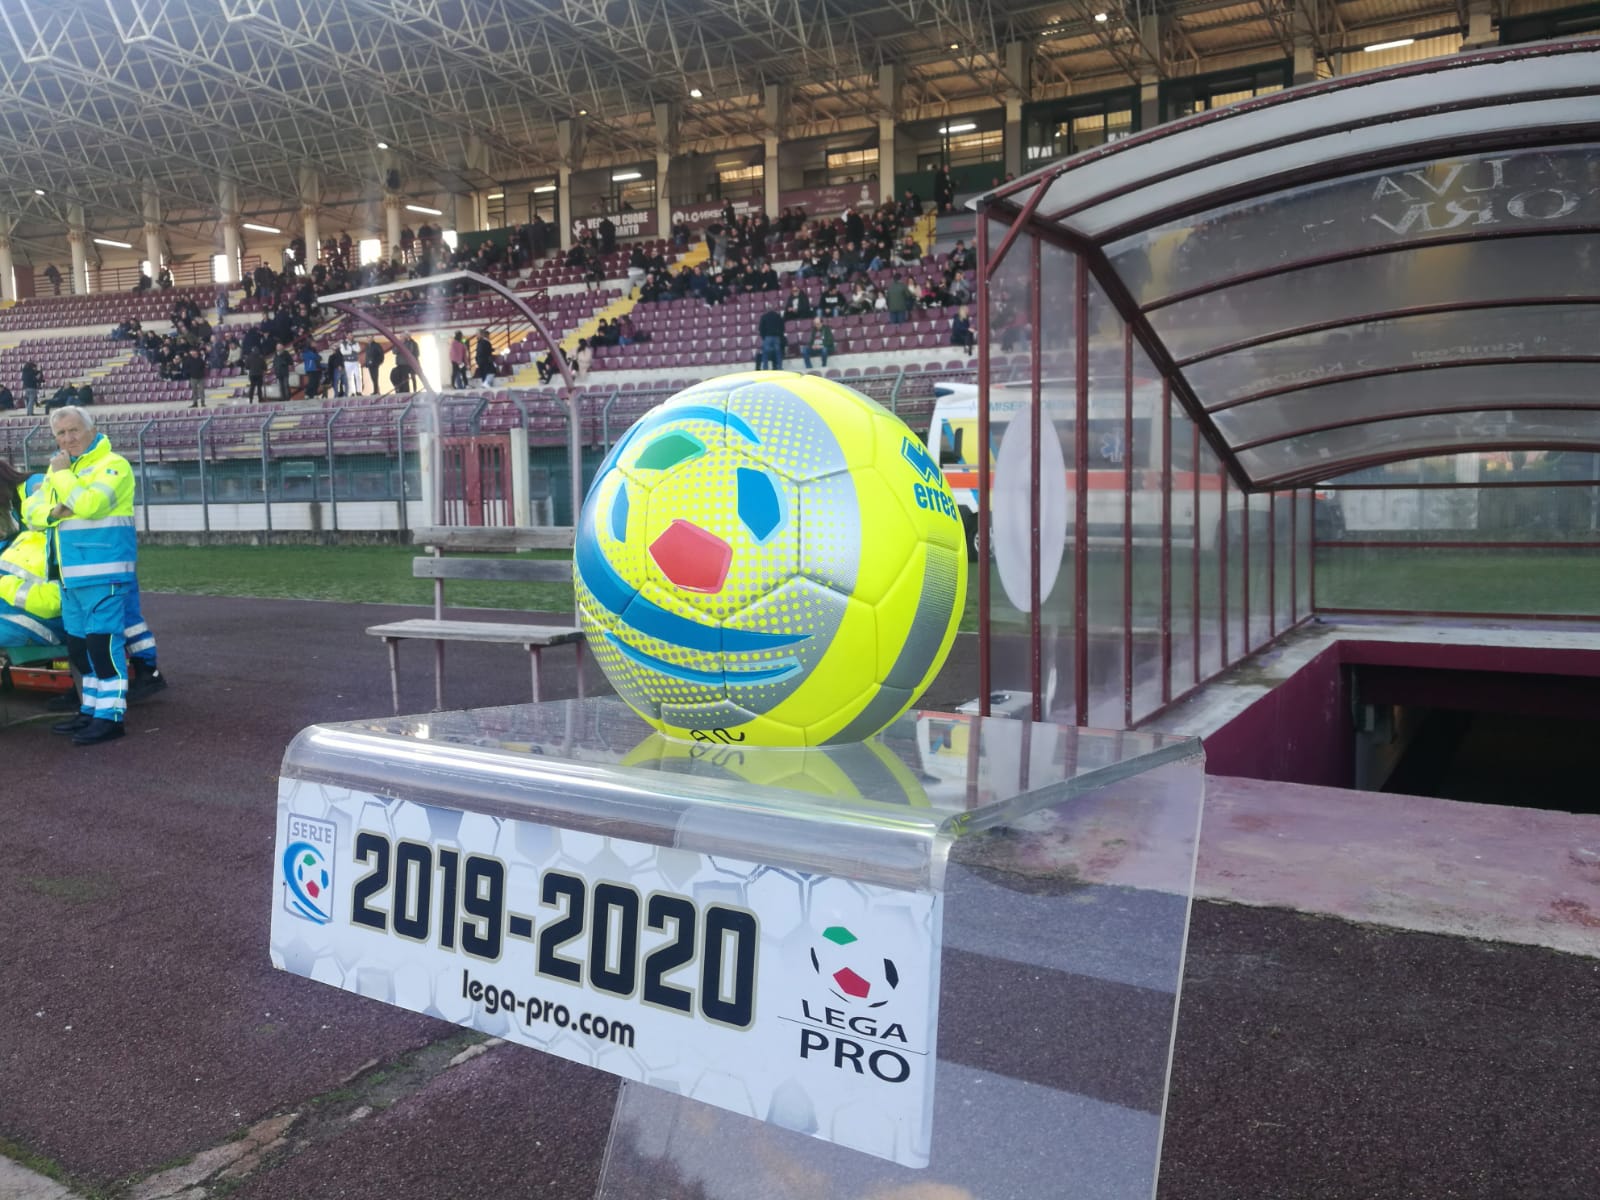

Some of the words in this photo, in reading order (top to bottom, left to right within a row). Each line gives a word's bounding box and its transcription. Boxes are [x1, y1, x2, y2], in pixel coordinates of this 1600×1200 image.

[291, 821, 333, 844] SERIE
[351, 829, 760, 1032] 2019-2020
[463, 969, 635, 1049] lega-pro.com
[801, 999, 908, 1043] LEGA
[799, 1028, 911, 1083] PRO
